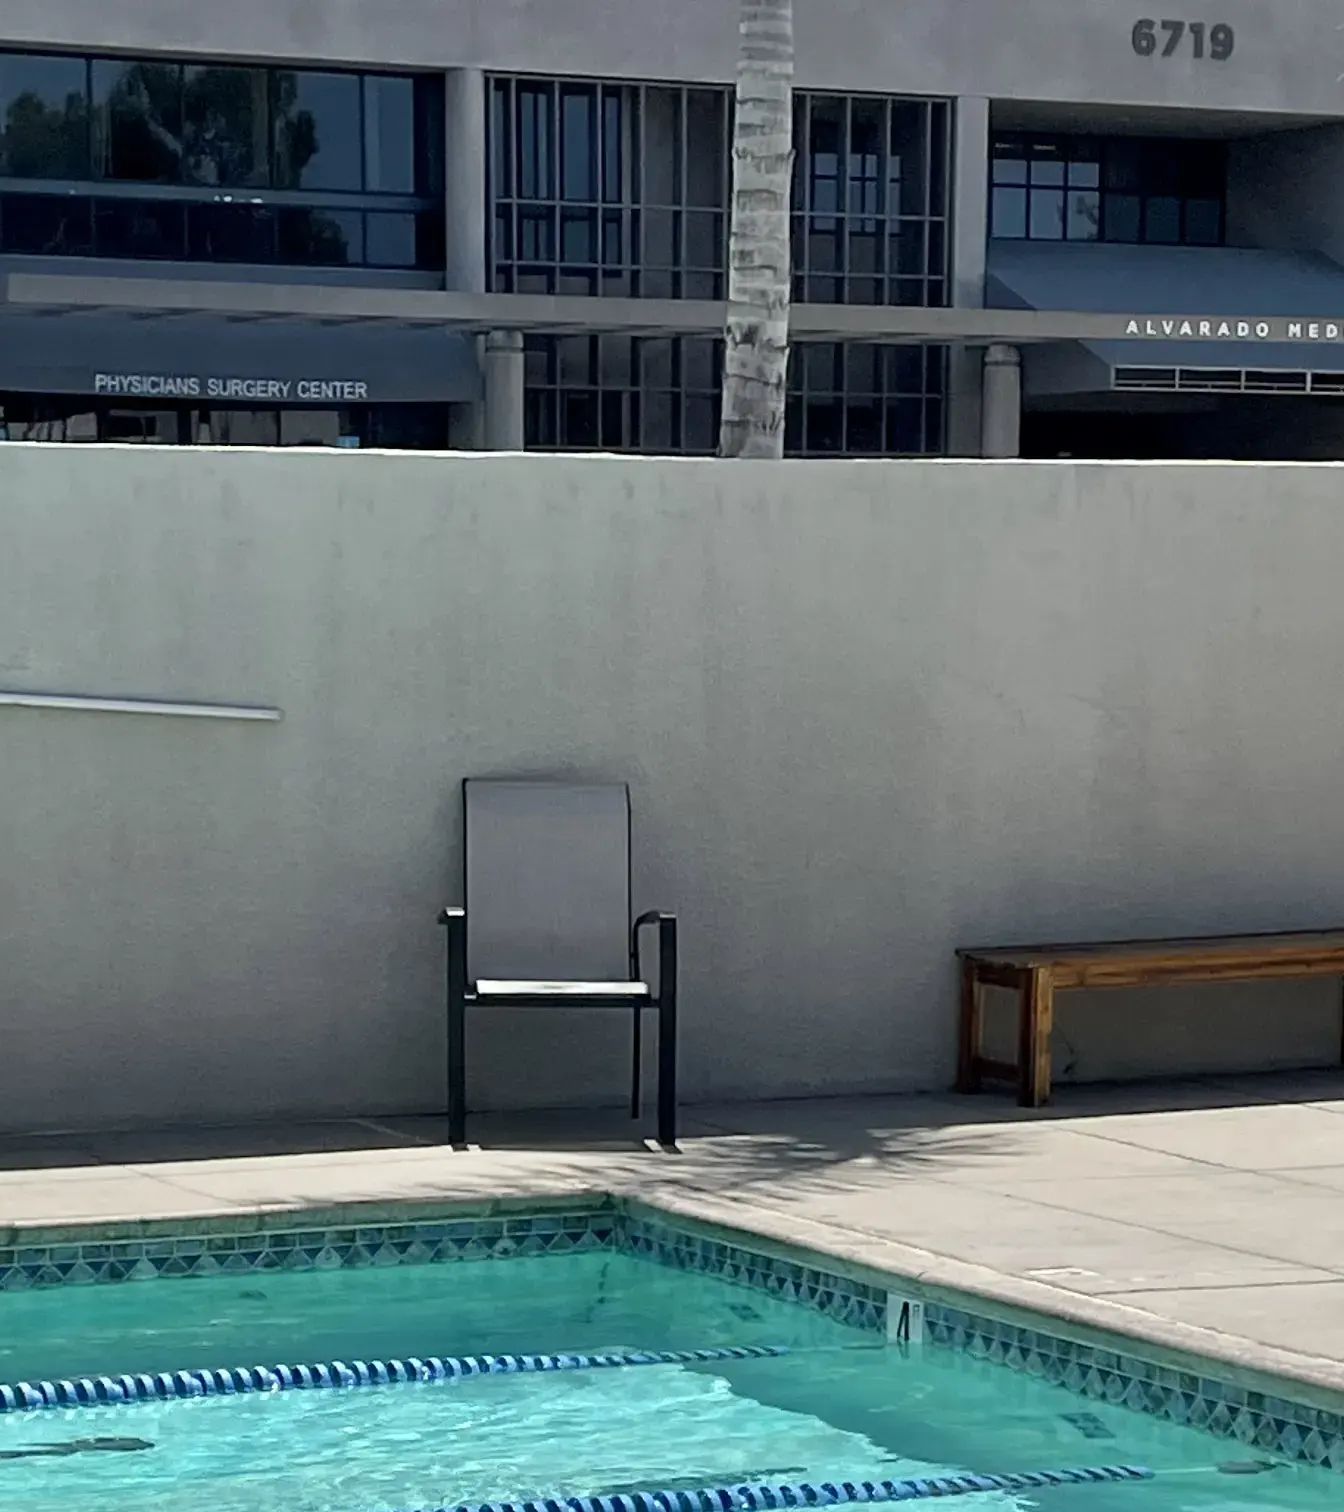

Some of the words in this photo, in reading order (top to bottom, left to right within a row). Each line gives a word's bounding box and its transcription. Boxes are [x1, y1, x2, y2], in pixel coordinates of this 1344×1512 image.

[1131, 18, 1235, 61] 6719
[1125, 320, 1269, 337] ALVARADO
[94, 373, 200, 396] PHYSICIANS
[207, 377, 291, 398] SURGERY
[297, 380, 368, 399] CENTER
